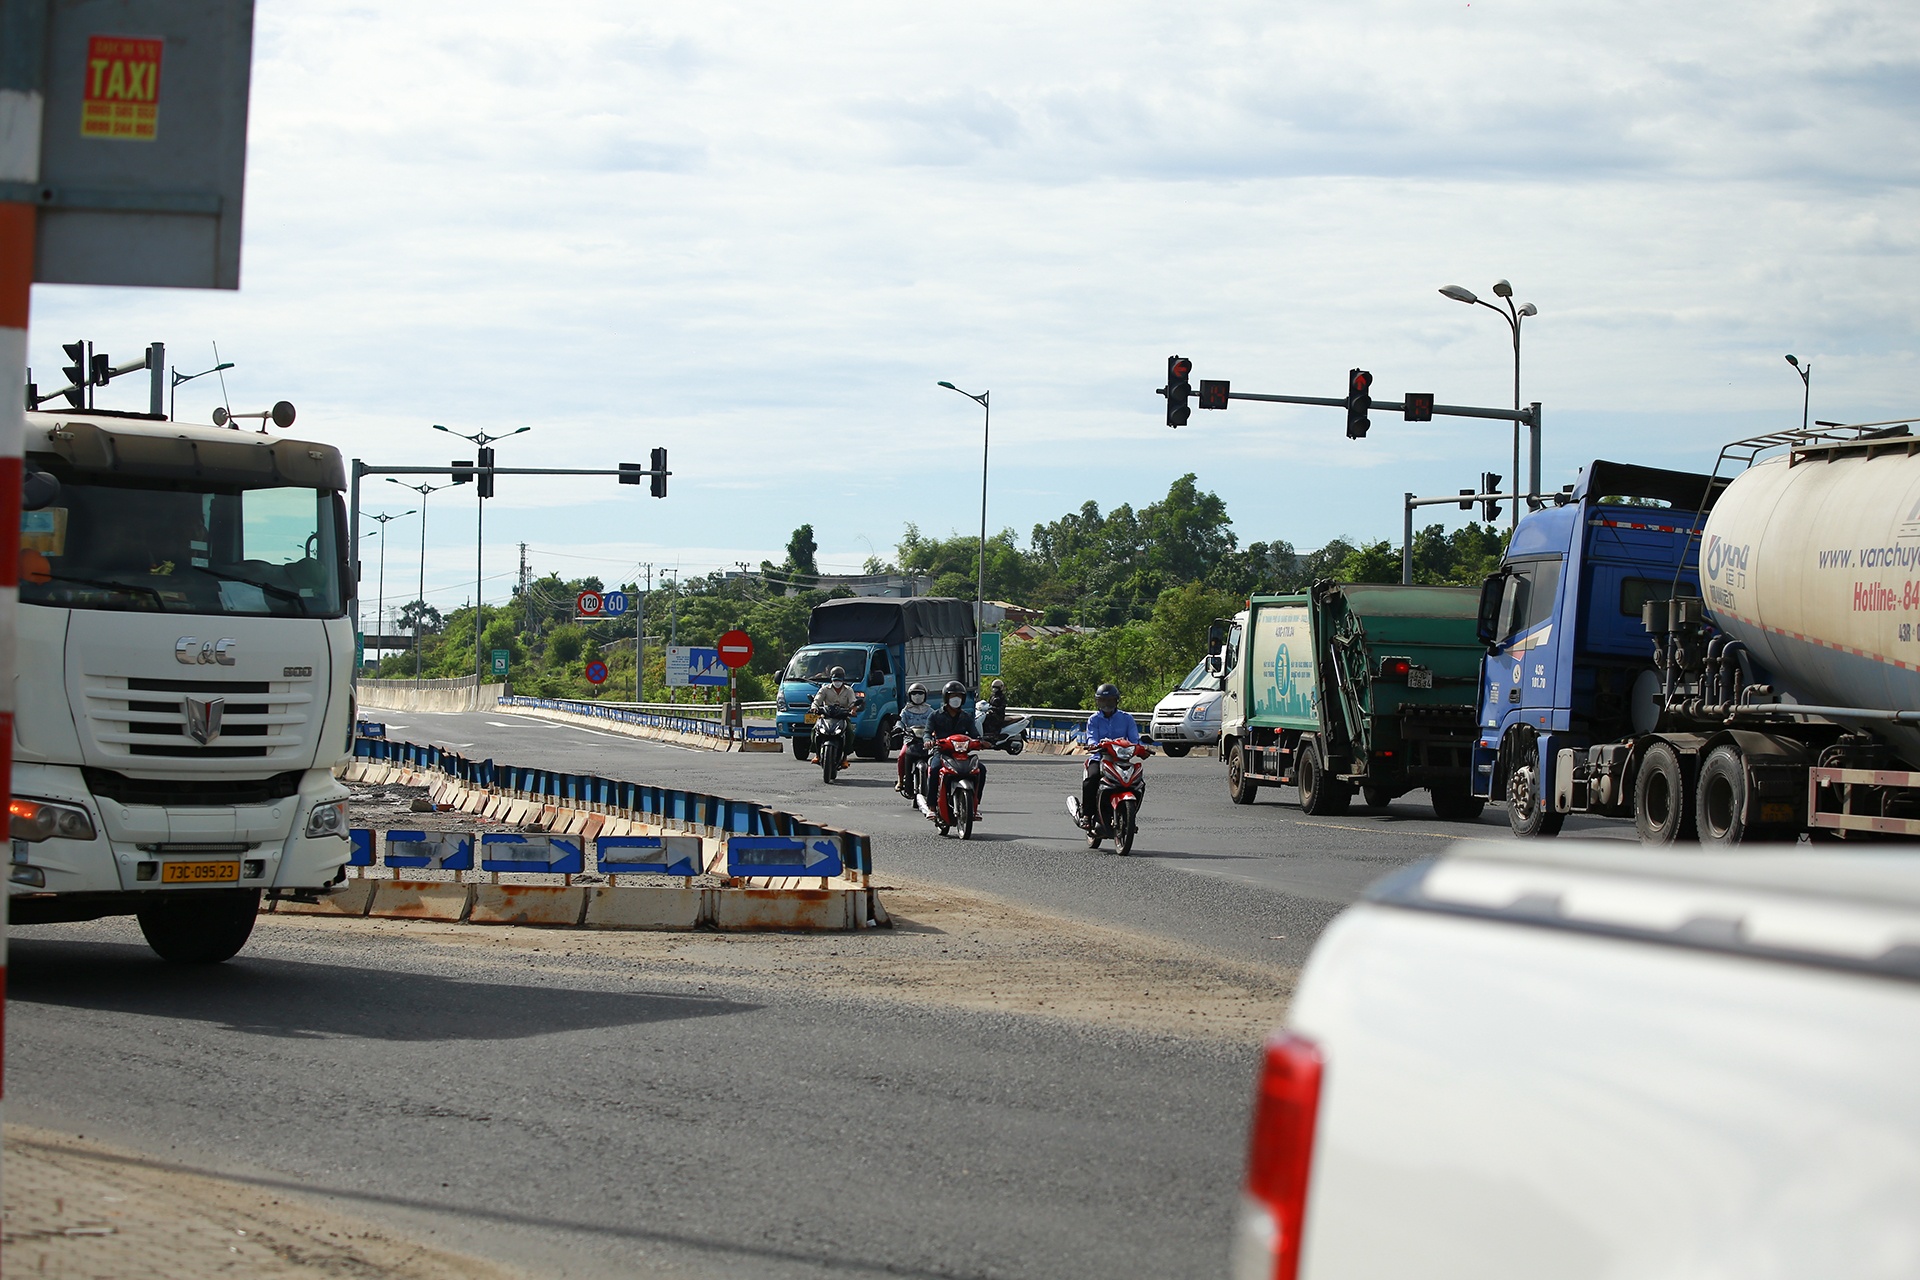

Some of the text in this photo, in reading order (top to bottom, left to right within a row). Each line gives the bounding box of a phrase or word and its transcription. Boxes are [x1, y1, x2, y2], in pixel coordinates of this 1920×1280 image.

[91, 60, 157, 100] TAXI
[583, 598, 598, 608] 120
[608, 595, 624, 611] 60
[175, 636, 236, 666] C&C
[1534, 664, 1544, 676] 43C
[1531, 677, 1546, 689] 101.70
[169, 865, 234, 879] 73C-095.23
